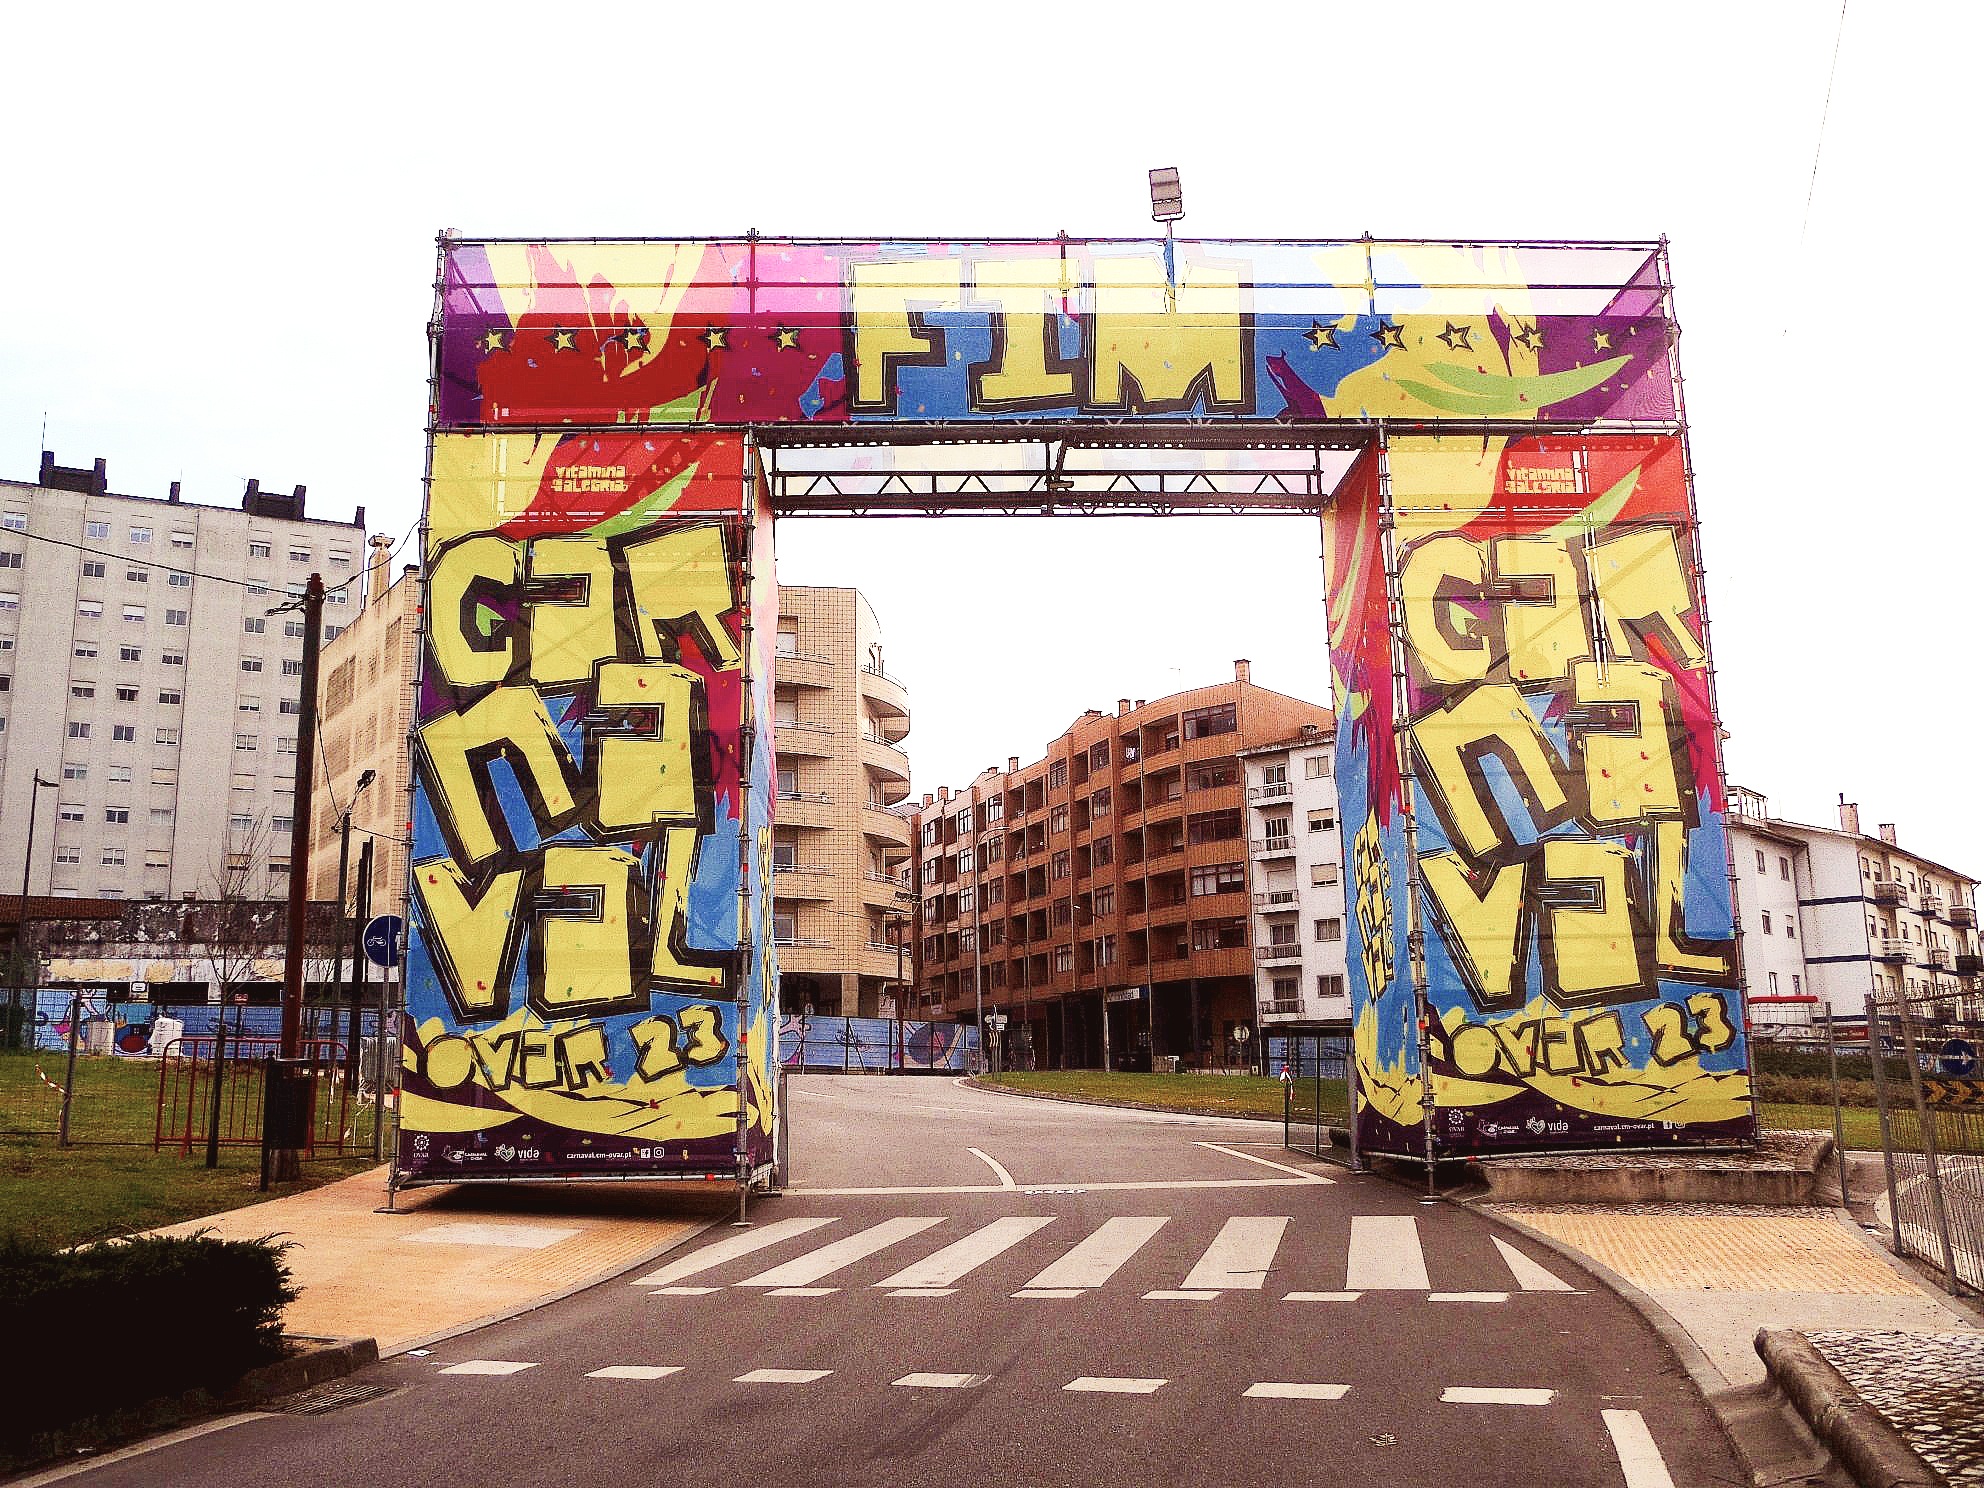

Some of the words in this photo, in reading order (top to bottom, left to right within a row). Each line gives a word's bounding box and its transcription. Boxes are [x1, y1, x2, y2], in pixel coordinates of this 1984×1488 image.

[845, 258, 1254, 414] FIM
[628, 1004, 728, 1082] 23
[1642, 994, 1738, 1067] 23
[517, 1147, 540, 1158] vida
[1548, 1120, 1569, 1131] vida
